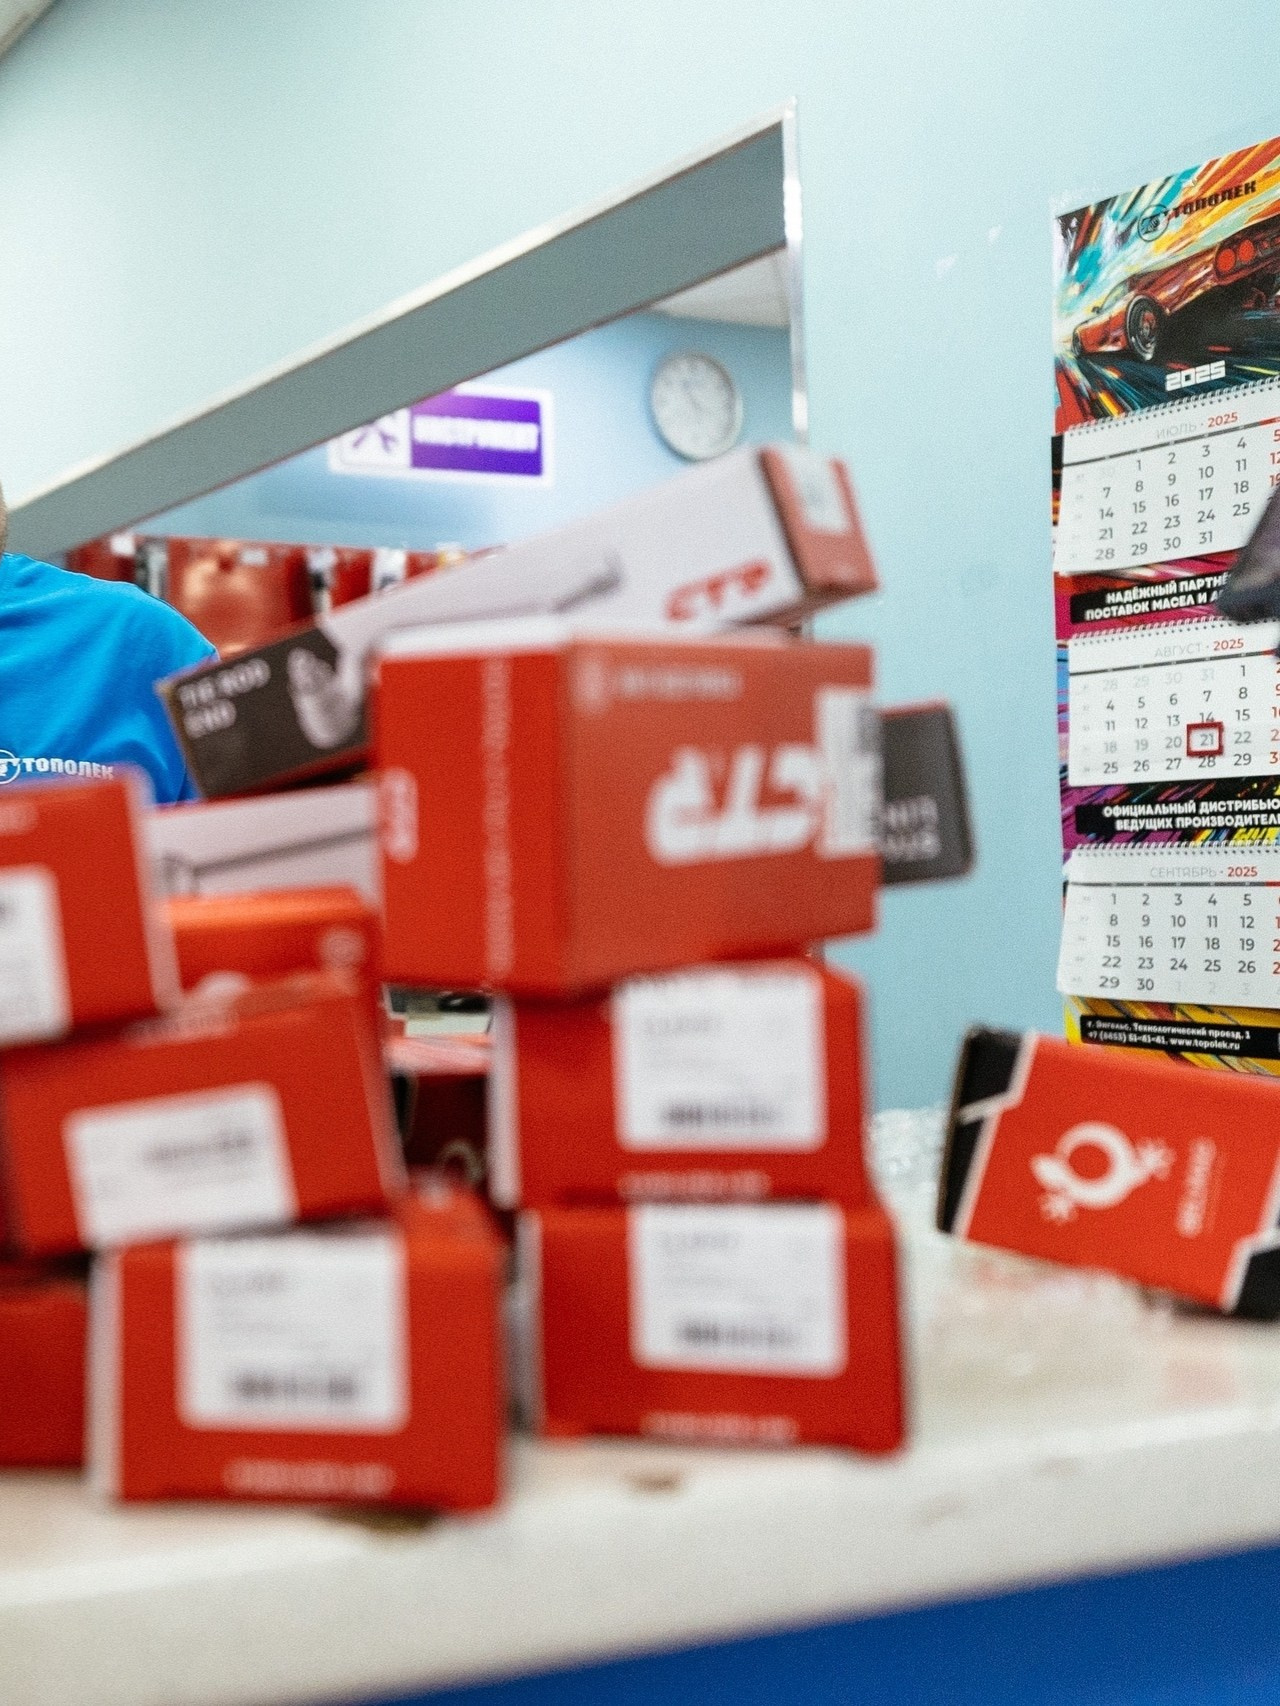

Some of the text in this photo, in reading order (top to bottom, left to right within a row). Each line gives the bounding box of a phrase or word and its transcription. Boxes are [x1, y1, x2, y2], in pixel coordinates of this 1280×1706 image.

[1165, 360, 1226, 391] 2025
[1156, 412, 1238, 439] ИЮЛЬ 2025
[1137, 460, 1142, 471] 1
[1168, 452, 1177, 465] 2
[1201, 445, 1210, 457] 3
[1237, 437, 1247, 449] 4
[1103, 487, 1111, 498] 7
[1135, 480, 1144, 493] 8
[1167, 473, 1176, 486] 9
[1199, 466, 1214, 479] 10
[1236, 459, 1247, 471] 11
[1100, 508, 1114, 520] 14
[1132, 501, 1146, 514] 15
[1165, 494, 1180, 507] 16
[1199, 487, 1214, 501] 17
[1234, 480, 1249, 494] 18
[1099, 502, 1250, 541] 21 22 23 24 25
[1095, 531, 1213, 561] 28 29 30 31
[1106, 580, 1177, 604] НАДЁЖНЫЙ
[1085, 602, 1150, 621] ПОСТАВОК
[1152, 594, 1195, 611] МАСЕЛ
[1197, 593, 1207, 604] И
[1155, 638, 1244, 659] АВГУСТ 2025
[1241, 665, 1246, 677] 1
[1106, 698, 1115, 711] 4
[1138, 697, 1146, 708] 5
[1170, 693, 1178, 705] 6
[1203, 690, 1212, 702] 7
[1238, 687, 1248, 699] 8
[1106, 720, 1115, 731] 11
[1135, 718, 1148, 730] 12
[1167, 715, 1180, 727] 13
[1200, 712, 1214, 723] 14
[1235, 709, 1250, 721] 15
[1105, 741, 1117, 753] 18
[1135, 739, 1149, 751] 19
[1165, 736, 1182, 749] 20
[1200, 734, 1214, 746] 21
[1234, 731, 1251, 744] 22
[22, 757, 114, 780] ТОПОЛЕК
[1103, 762, 1119, 774] 25
[1133, 760, 1150, 772] 26
[1166, 758, 1181, 770] 27
[1198, 756, 1215, 768] 28
[1234, 753, 1252, 766] 29
[1102, 798, 1280, 818] ОФИЦИАЛЬНЫЙ ДИСТРИБЬЮ
[1115, 812, 1280, 832] ВЕДУЩИХ ПРОИЗВОДИТЕЛ
[1150, 866, 1258, 878] СЕНТЯБРЬ 2025
[1111, 893, 1252, 906] 1 2 3 4 5
[1109, 914, 1255, 929] 8 9 10 11 12
[1106, 935, 1120, 947] 15
[1139, 936, 1153, 948] 16
[1171, 936, 1186, 948] 17
[1205, 937, 1220, 949] 18
[1239, 938, 1255, 951] 19
[1101, 955, 1121, 968] 22
[1137, 957, 1154, 969] 23
[1170, 958, 1188, 971] 24
[1204, 959, 1221, 972] 25
[1238, 960, 1256, 973] 26
[1099, 976, 1120, 989] 29
[1137, 978, 1154, 991] 30
[1132, 1022, 1207, 1037] Технологический
[1170, 1037, 1241, 1050] www.topolek.ru
